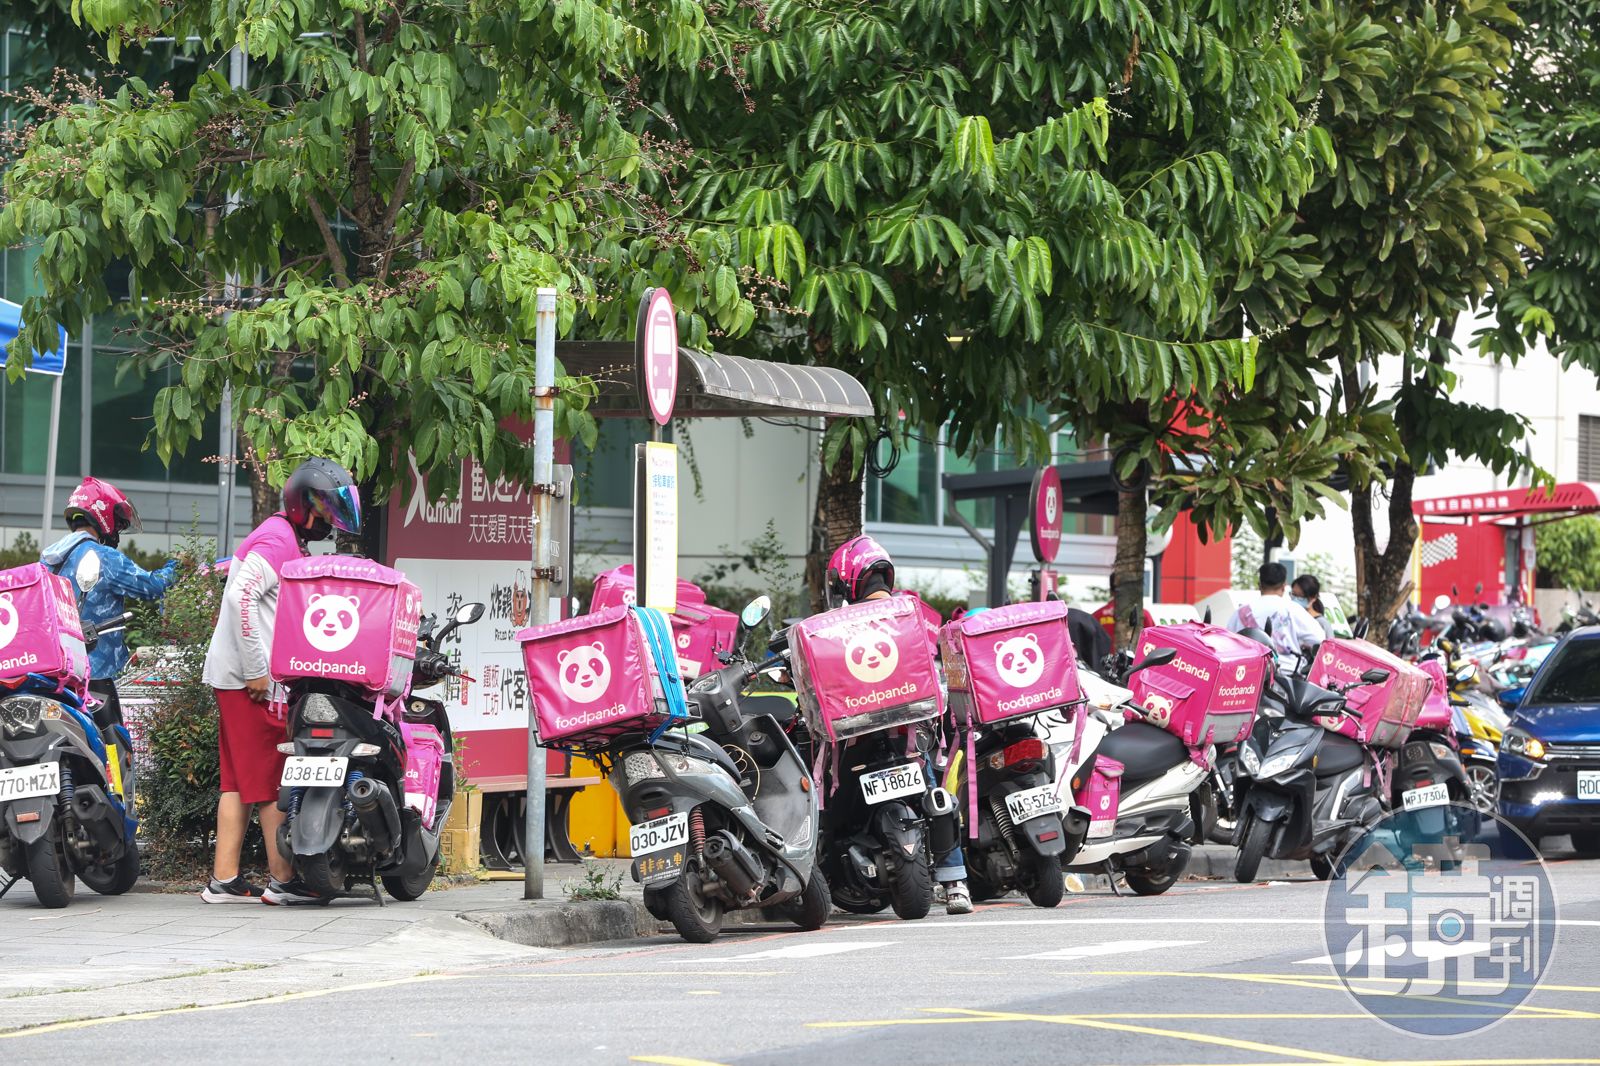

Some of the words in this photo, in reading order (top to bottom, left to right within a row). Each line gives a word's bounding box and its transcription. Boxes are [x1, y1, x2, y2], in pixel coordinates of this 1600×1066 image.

[0, 651, 38, 671] anda
[289, 656, 366, 676] foodpanda
[1168, 657, 1210, 682] dpanda
[500, 666, 531, 711] 代客
[844, 681, 917, 709] foodpanda
[996, 687, 1063, 713] foodpanda
[1218, 684, 1256, 698] foodpanda
[555, 702, 627, 730] foodpanda
[864, 771, 922, 798] NFJ-8826
